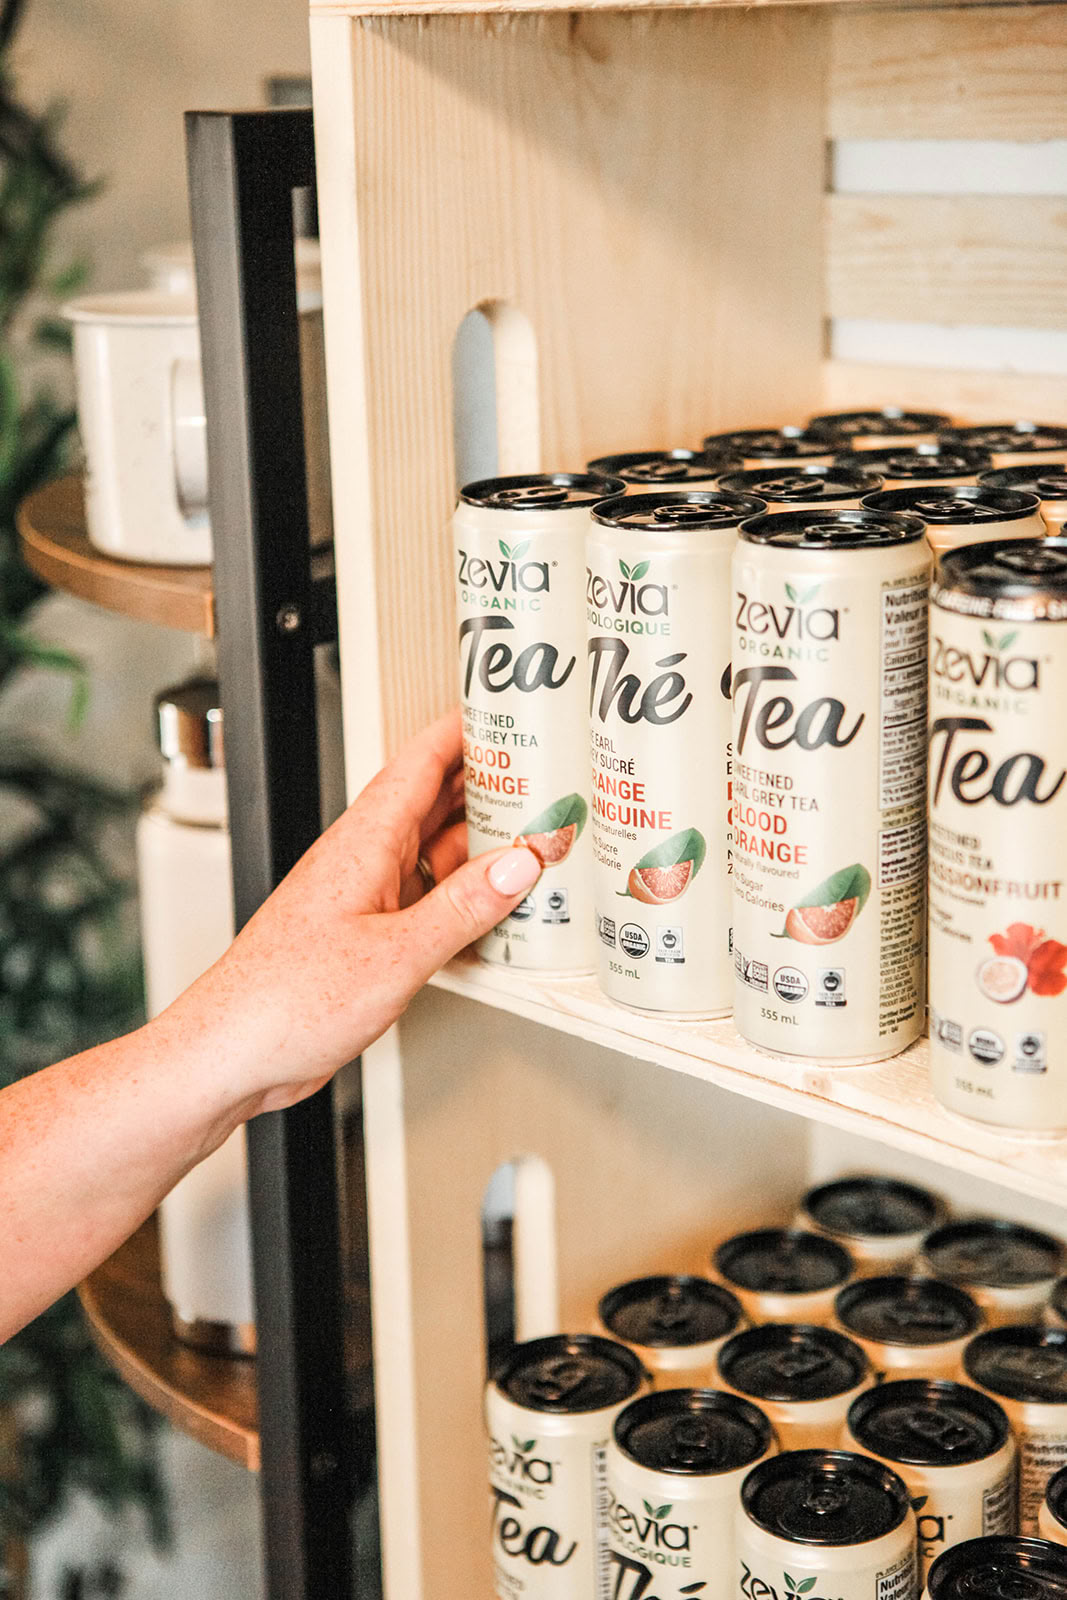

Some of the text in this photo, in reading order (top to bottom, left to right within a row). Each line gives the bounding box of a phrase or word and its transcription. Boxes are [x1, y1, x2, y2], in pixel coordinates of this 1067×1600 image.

[461, 590, 542, 612] ORGANIC
[459, 615, 577, 700] Tea
[739, 636, 830, 662] ORGANIC
[587, 636, 693, 726] Thé
[733, 665, 866, 757] Tea
[479, 728, 507, 745] GREY
[512, 732, 538, 747] TEA
[595, 732, 617, 754] EARL
[600, 753, 636, 776] SUCRÉ
[931, 716, 1067, 808] Tea
[591, 767, 646, 803] RANGE
[752, 787, 785, 809] GREY
[790, 795, 820, 812] TEA
[591, 793, 673, 830] ANGUINE
[733, 798, 788, 835] BLOOD
[476, 823, 511, 840] Calories
[602, 822, 637, 841] naturelles
[598, 836, 619, 856] Sucre
[733, 825, 809, 865] ORANGE
[598, 850, 622, 871] Calorie
[740, 873, 764, 892] Sugar
[745, 891, 785, 913] Calories
[511, 932, 529, 942] mL
[624, 930, 643, 942] USDA
[608, 960, 640, 980] 355 mL
[779, 974, 801, 985] USDA
[760, 1007, 799, 1026] 355 mL
